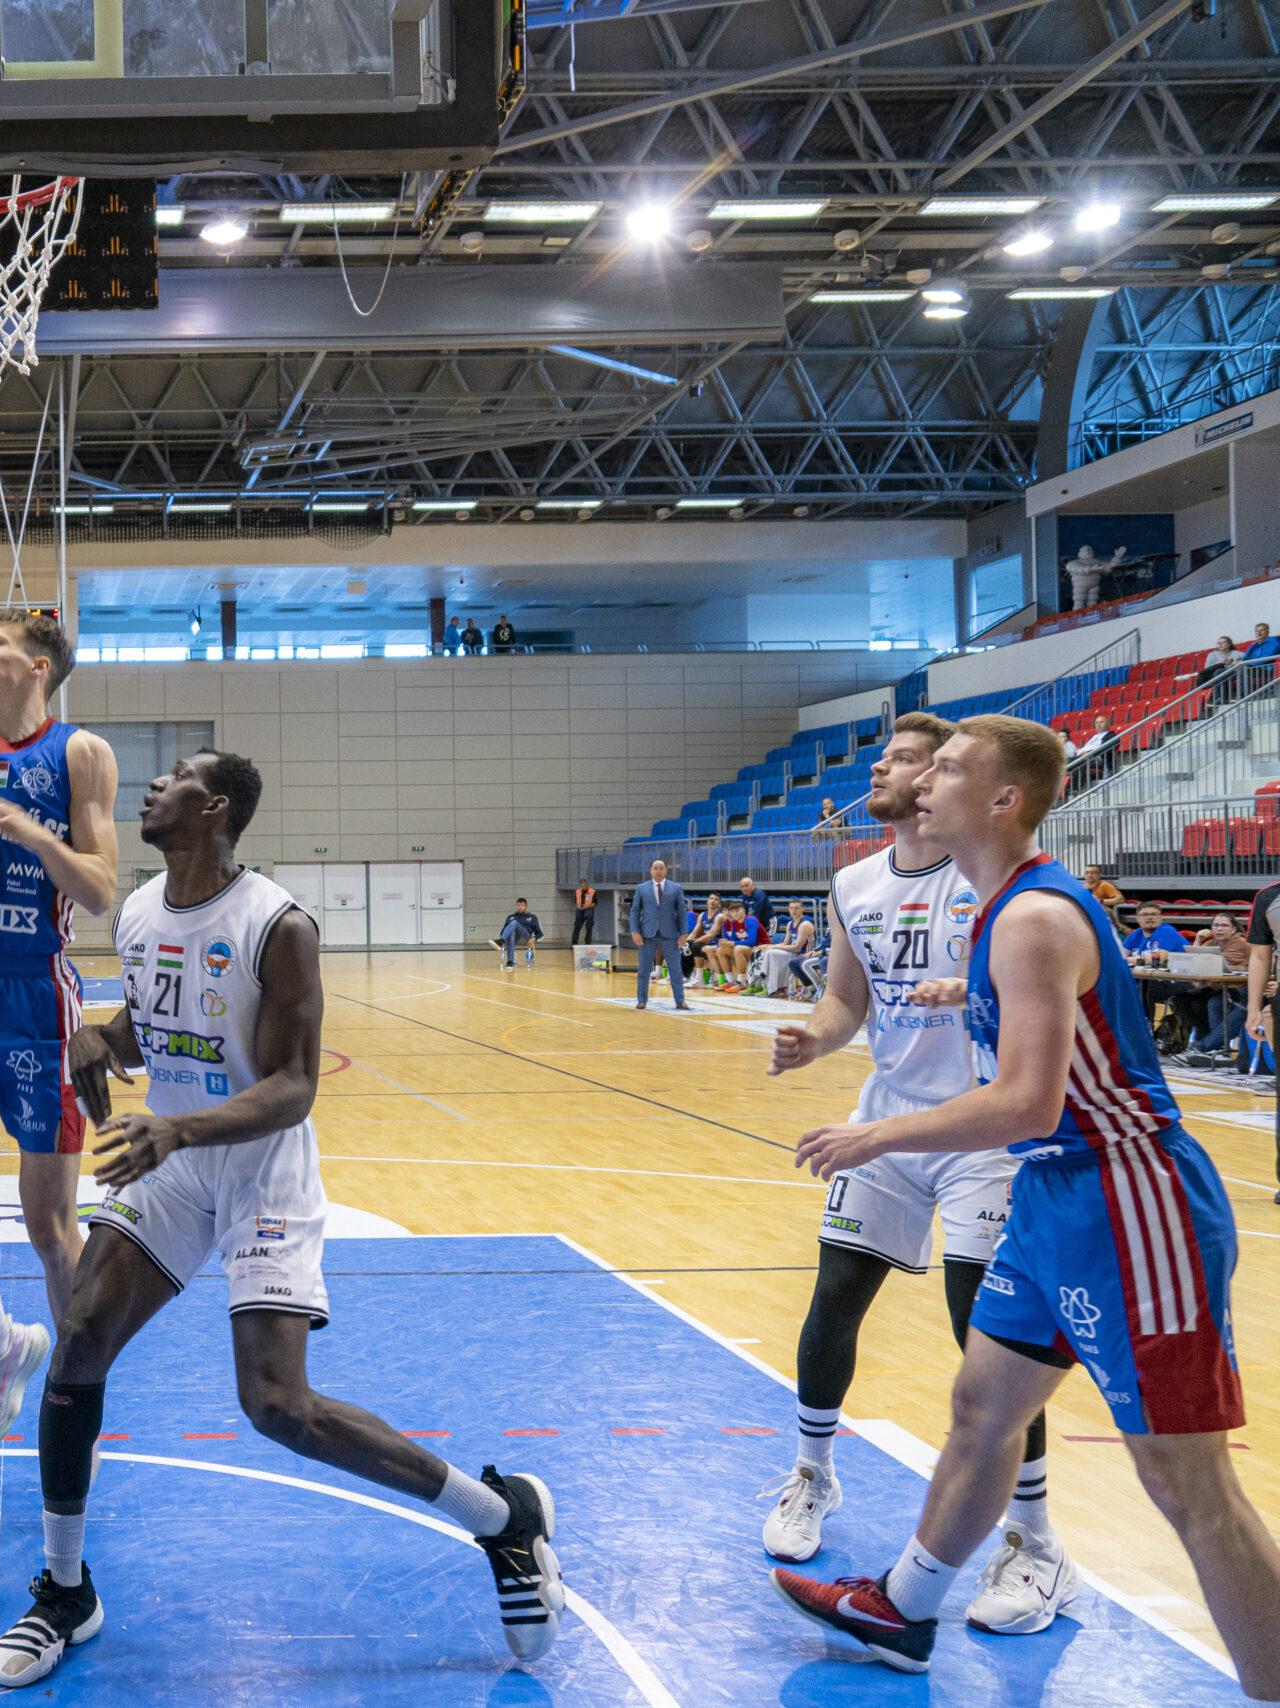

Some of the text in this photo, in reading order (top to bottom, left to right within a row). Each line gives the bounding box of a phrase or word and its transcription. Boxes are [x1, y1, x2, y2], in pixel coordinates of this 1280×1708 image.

[6, 862, 44, 880] MVM
[858, 912, 883, 922] JAKO
[892, 929, 929, 969] 20
[152, 972, 182, 1017] 21
[17, 1084, 34, 1094] PAKS
[264, 1285, 292, 1296] JAKO
